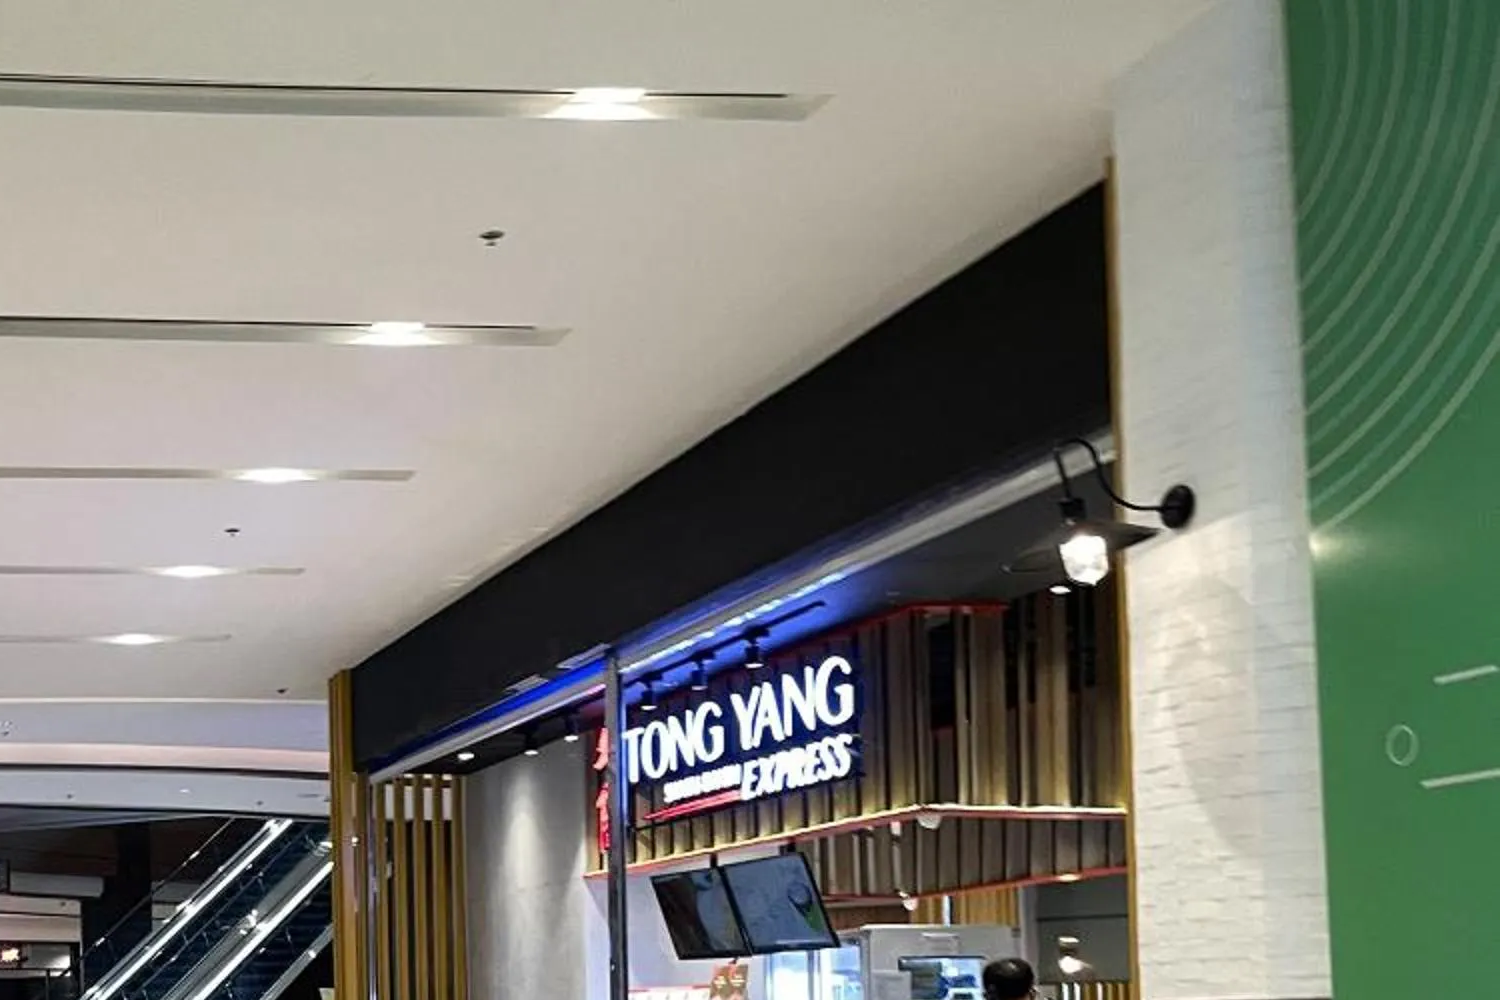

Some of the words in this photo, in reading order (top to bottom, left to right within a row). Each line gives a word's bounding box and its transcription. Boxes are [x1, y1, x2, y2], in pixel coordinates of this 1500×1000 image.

[622, 701, 725, 784] TONG
[731, 656, 855, 750] YANG
[740, 733, 854, 801] EXPRESS
